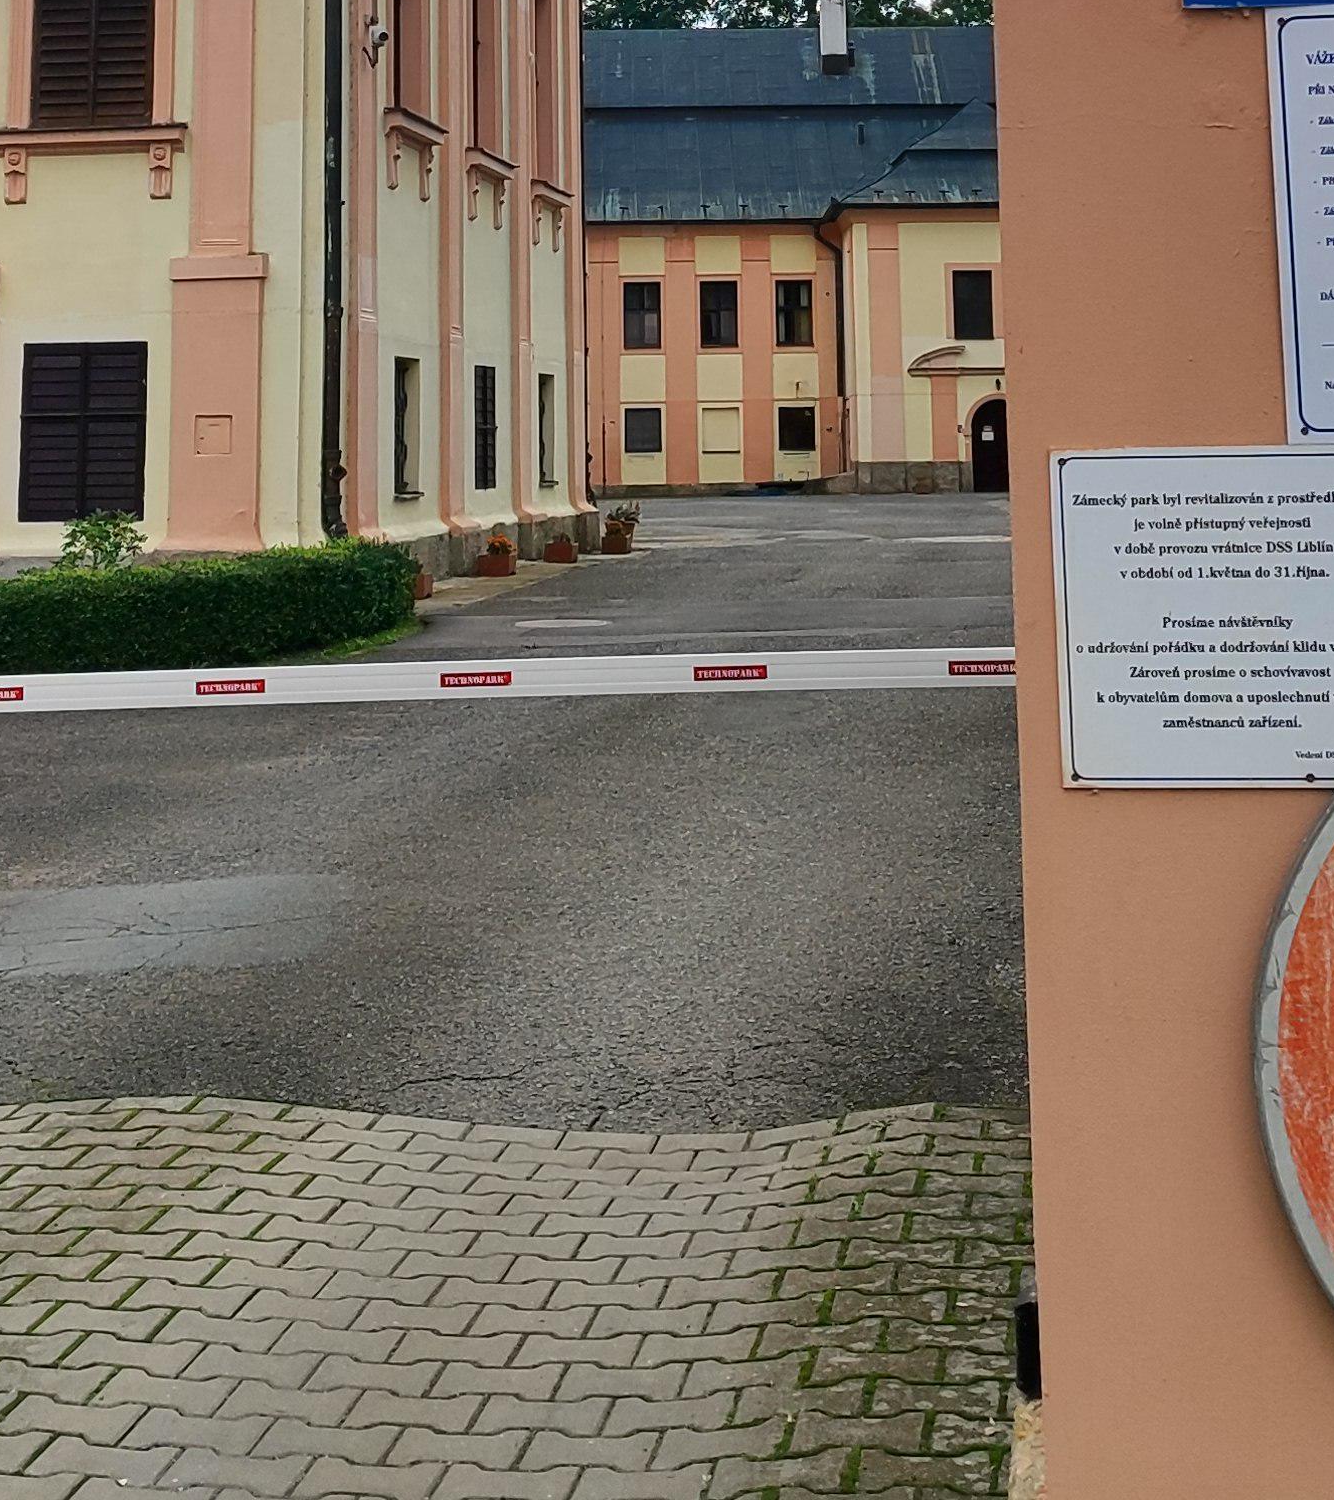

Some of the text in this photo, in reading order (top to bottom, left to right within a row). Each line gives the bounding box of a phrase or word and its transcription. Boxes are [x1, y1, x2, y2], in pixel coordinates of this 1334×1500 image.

[1073, 494, 1126, 507] Zámecký
[1131, 494, 1159, 507] park
[1163, 494, 1181, 507] byl
[1185, 492, 1264, 504] revitalizován
[1134, 516, 1311, 532] je volně přístupný veřejnosti
[1114, 541, 1333, 556] v době provozu vrátnice DSS Liblín
[1120, 566, 1329, 580] v období od 1.května do 31.října.
[1163, 616, 1293, 629] Prosíme návštěvníky
[1076, 645, 1083, 653] o
[1088, 642, 1148, 653] udržování
[1153, 641, 1205, 655] pořádku
[1220, 641, 1289, 652] dodržování
[1293, 641, 1326, 652] klidu
[1130, 666, 1331, 680] Zároveň prosíme o schovívavost
[1097, 692, 1105, 703] k
[1109, 691, 1179, 705] obyvatelům
[1184, 691, 1233, 702] domova
[1247, 691, 1329, 705] uposlechnutí
[1163, 716, 1302, 728] zaměstnanců zařízení.
